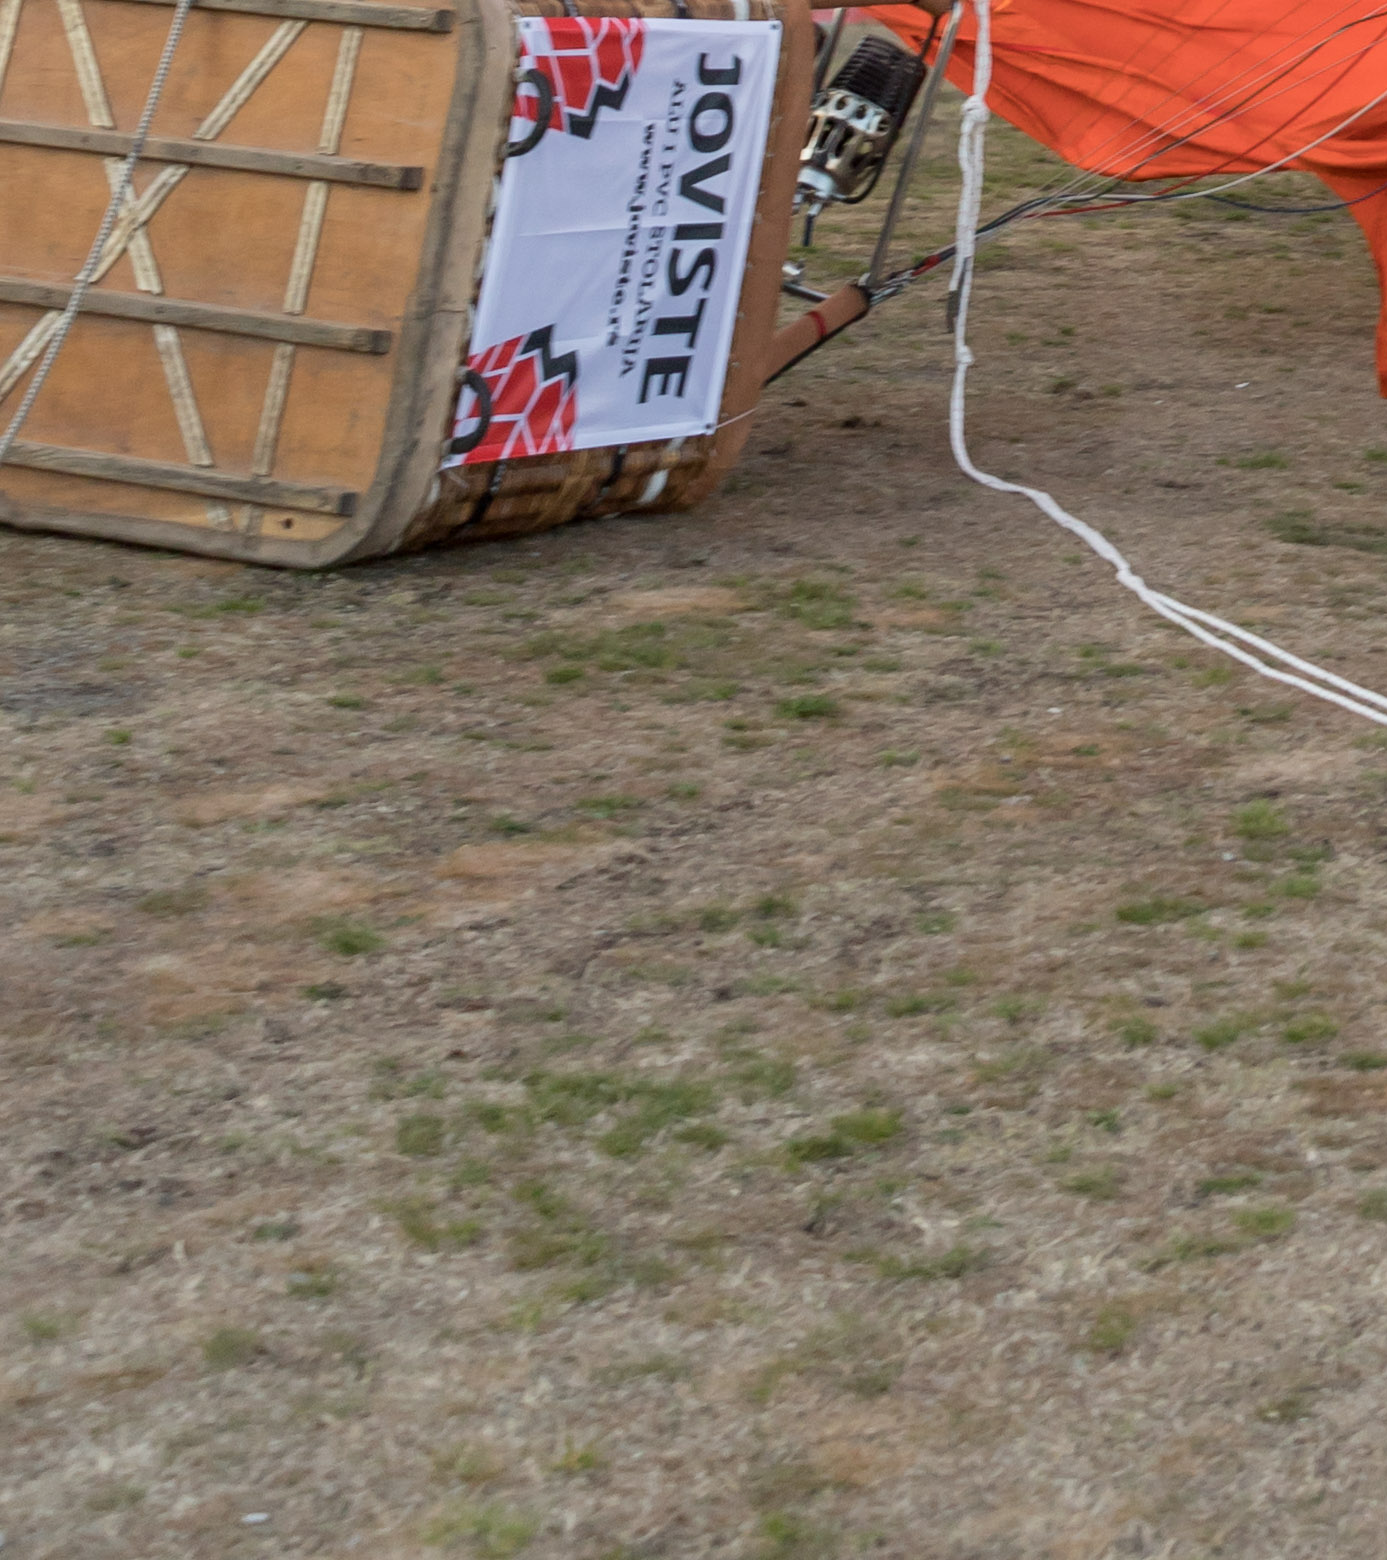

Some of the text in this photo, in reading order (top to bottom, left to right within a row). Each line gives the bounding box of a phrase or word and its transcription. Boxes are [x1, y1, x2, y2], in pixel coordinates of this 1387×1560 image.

[667, 78, 687, 132] ALU
[652, 162, 674, 217] PVC
[638, 51, 742, 404] JOVISTE
